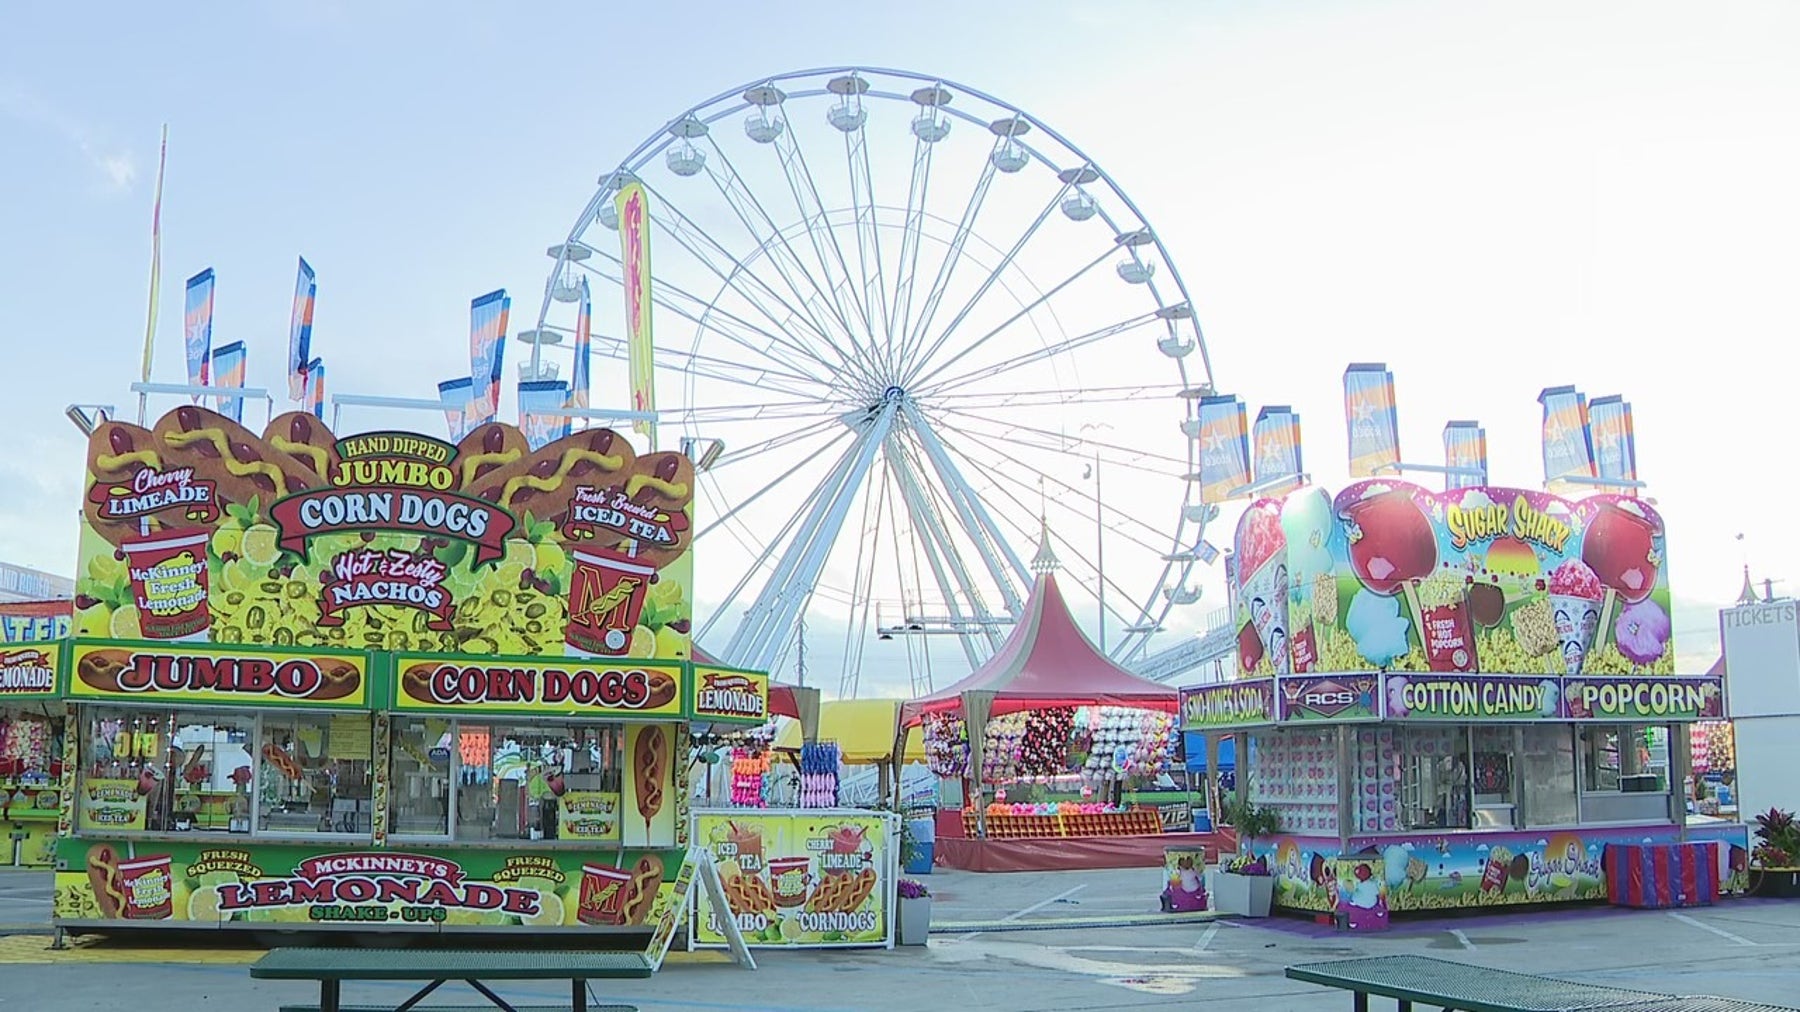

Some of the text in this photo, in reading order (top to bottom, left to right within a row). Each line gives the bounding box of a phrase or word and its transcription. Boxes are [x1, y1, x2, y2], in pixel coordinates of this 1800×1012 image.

[346, 437, 447, 463] HAND DIPPED
[134, 466, 196, 493] Cherry
[334, 461, 454, 490] JUMBO
[109, 485, 209, 515] LIMEADE
[575, 486, 606, 504] Fresh
[301, 492, 489, 537] CORN DOGS
[574, 505, 671, 542] ICED TEA
[335, 552, 372, 582] Hot
[388, 552, 444, 588] Zesty
[151, 578, 195, 594] Fresh
[333, 581, 443, 609] NACHOS
[1432, 618, 1455, 629] FRESH
[1725, 606, 1795, 628] TICKETS
[1431, 637, 1464, 649] POPCORN
[1437, 629, 1452, 639] HOT
[122, 654, 319, 695] JUMBO
[432, 665, 649, 708] CORN DOGS
[698, 689, 763, 714] LEMONADE
[1239, 687, 1264, 720] SODA
[1305, 692, 1353, 705] RCS
[1402, 681, 1545, 714] COTTON CANDY
[1583, 683, 1706, 714] POPCORN
[1161, 810, 1187, 823] VIP
[718, 842, 738, 855] ICED
[807, 839, 835, 850] CHERRY
[202, 850, 249, 861] FRESH
[507, 856, 553, 867] FRESH
[739, 855, 762, 870] TEA
[822, 853, 862, 869] LIMEADE
[187, 860, 262, 878] SQUEEZED
[493, 866, 565, 883] SQUEEZED
[218, 877, 541, 917] LEMONADE
[310, 905, 389, 922] SHAKE
[402, 905, 447, 922] UPS
[707, 913, 767, 931] JMBO
[800, 912, 875, 931] CORNDOGS
